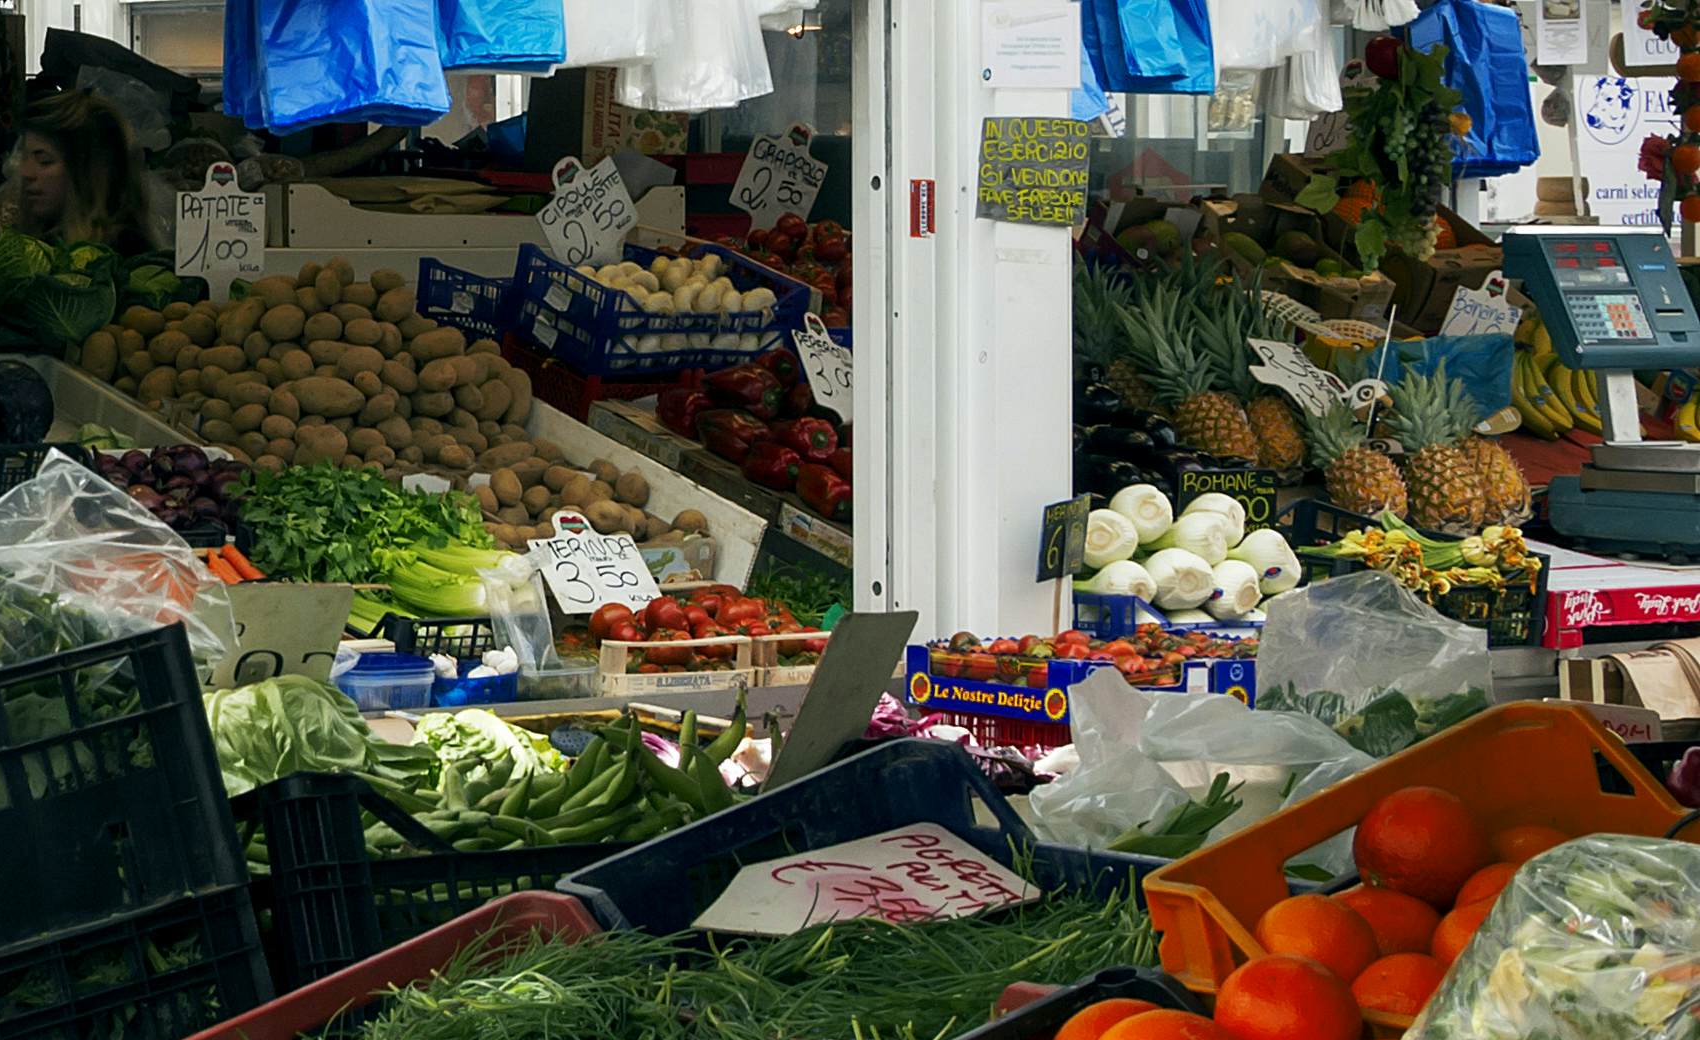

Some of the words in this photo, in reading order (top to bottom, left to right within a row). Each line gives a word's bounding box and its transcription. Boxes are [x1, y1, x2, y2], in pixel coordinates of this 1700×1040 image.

[985, 121, 1004, 138] IN
[1007, 118, 1088, 142] QUESTO
[1596, 183, 1628, 200] carni
[1631, 183, 1661, 200] selez
[181, 193, 251, 219] PATATE
[933, 684, 950, 700] Le
[951, 684, 996, 705] Nostre
[996, 690, 1043, 712] Delizie
